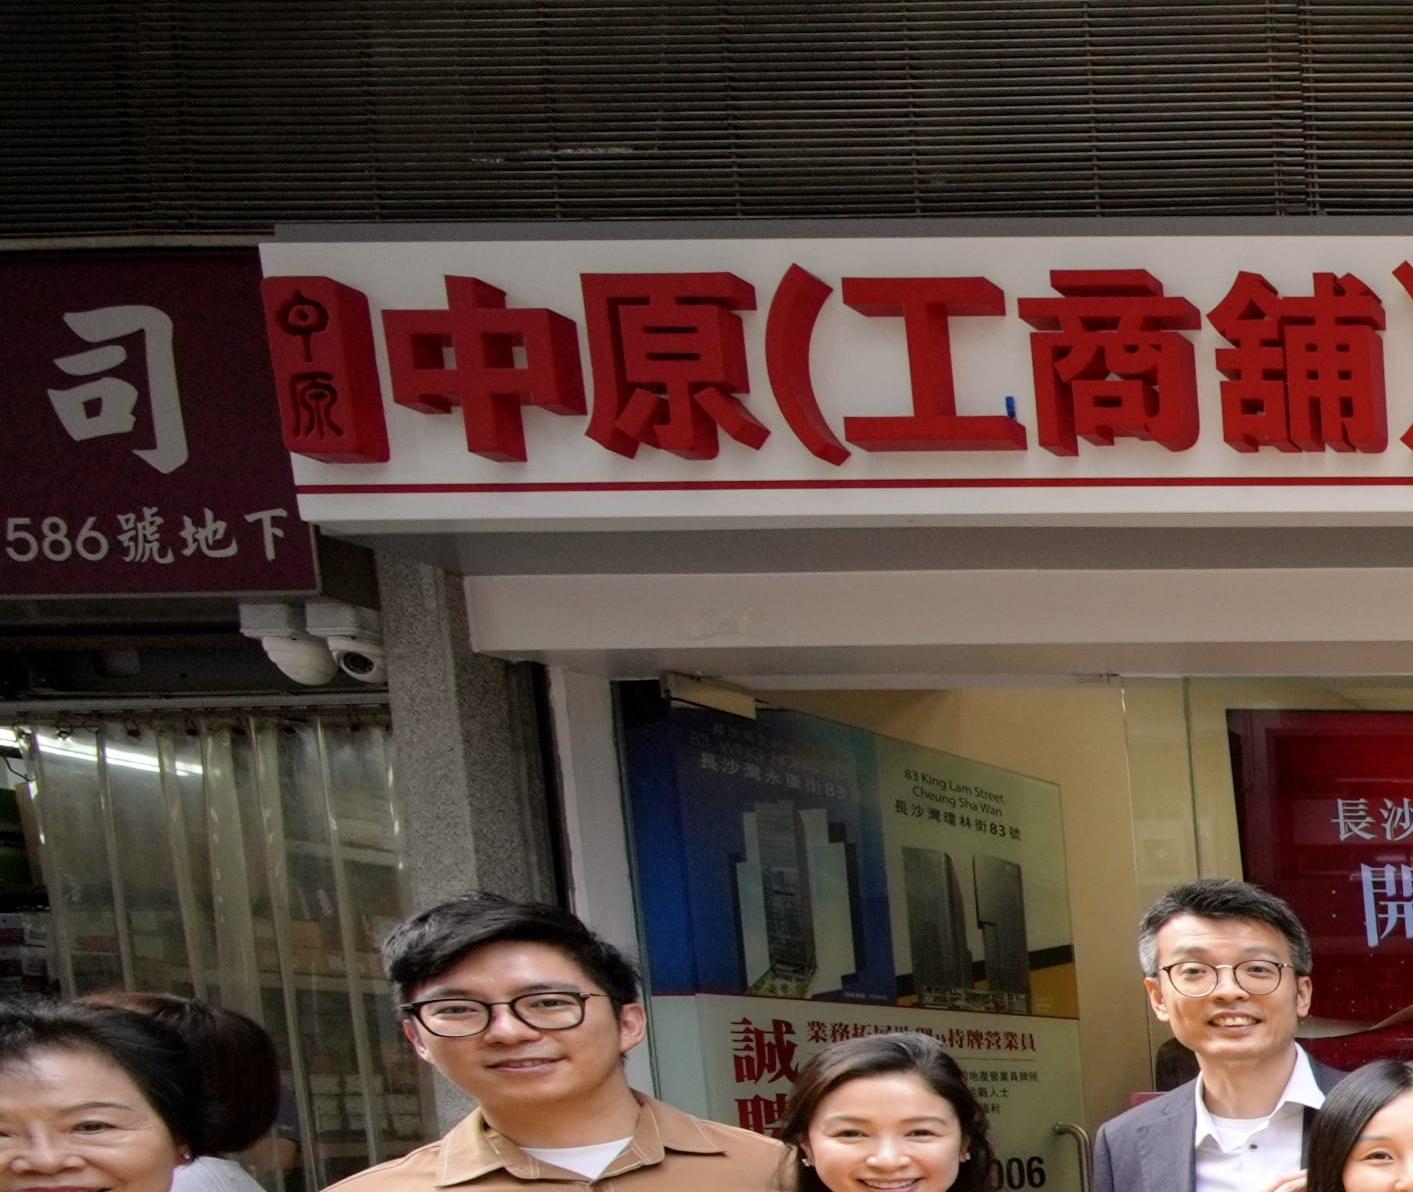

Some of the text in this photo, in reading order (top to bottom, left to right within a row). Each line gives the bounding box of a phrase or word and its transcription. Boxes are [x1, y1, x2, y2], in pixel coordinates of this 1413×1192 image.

[48, 305, 188, 474] 司
[5, 506, 289, 565] 586號地下
[912, 786, 956, 808] Cheung
[980, 803, 1002, 817] Wan
